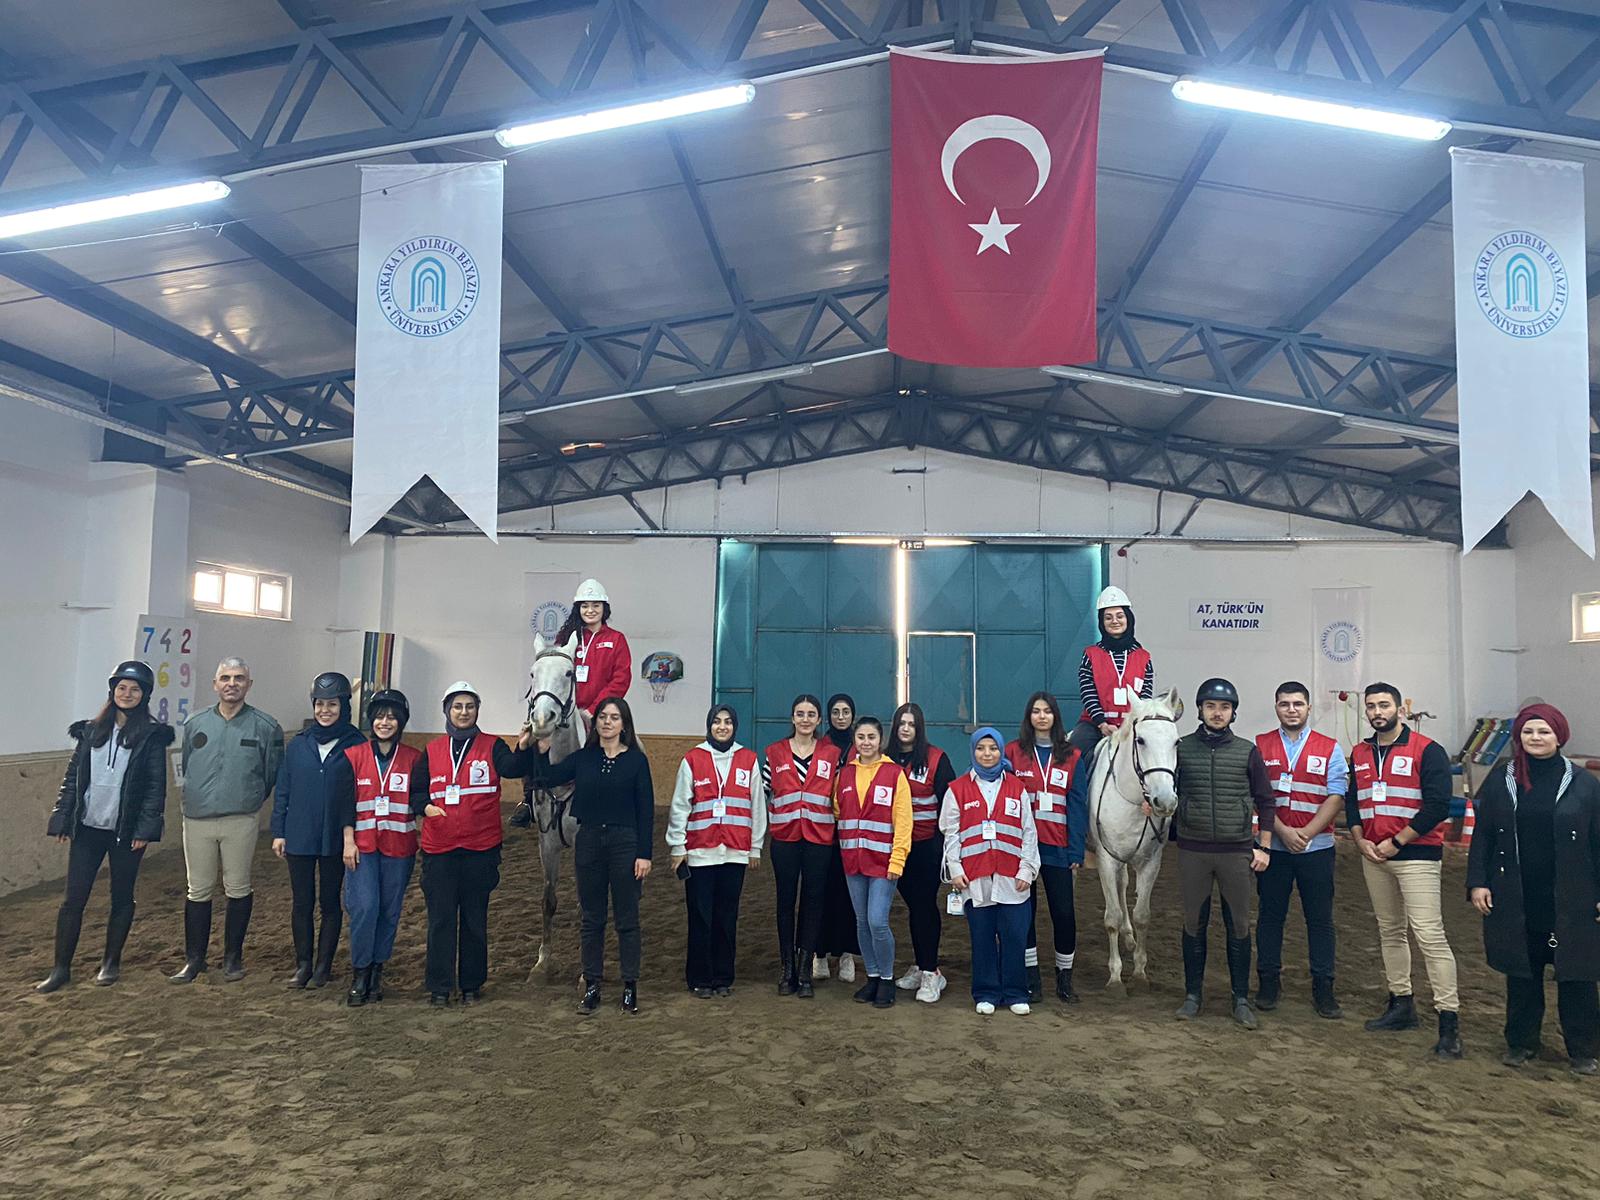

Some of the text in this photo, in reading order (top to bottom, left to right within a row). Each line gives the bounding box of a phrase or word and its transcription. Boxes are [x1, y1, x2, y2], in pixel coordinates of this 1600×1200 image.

[380, 238, 477, 303] ANKARA YILDIRIM BEYAZIT
[1476, 234, 1566, 306] ANKARA YILDIRIM BEYAZIT
[389, 308, 466, 335] ÜNİVERSİTESİ
[1487, 307, 1558, 336] ÜNİVERSİTESİ
[1197, 604, 1213, 615] AT,
[1202, 619, 1260, 629] KANATIDIR
[143, 627, 192, 654] 7 4 2
[157, 662, 191, 688] 6 9
